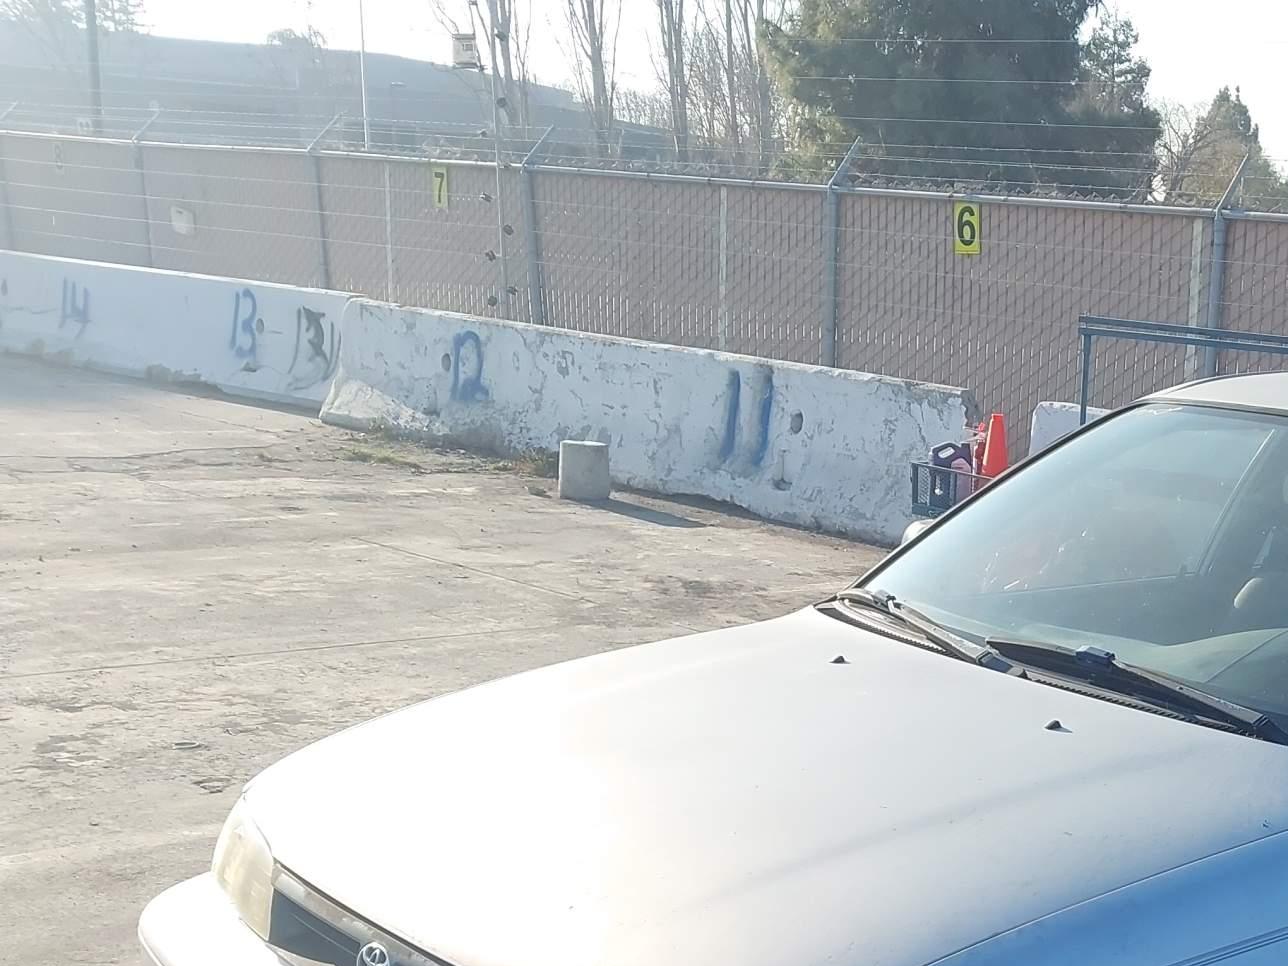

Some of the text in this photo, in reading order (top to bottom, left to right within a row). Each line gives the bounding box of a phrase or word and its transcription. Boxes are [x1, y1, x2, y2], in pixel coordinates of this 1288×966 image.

[434, 171, 445, 204] 7
[957, 205, 976, 247] 6
[230, 287, 258, 361] 13
[717, 366, 774, 467] 11
